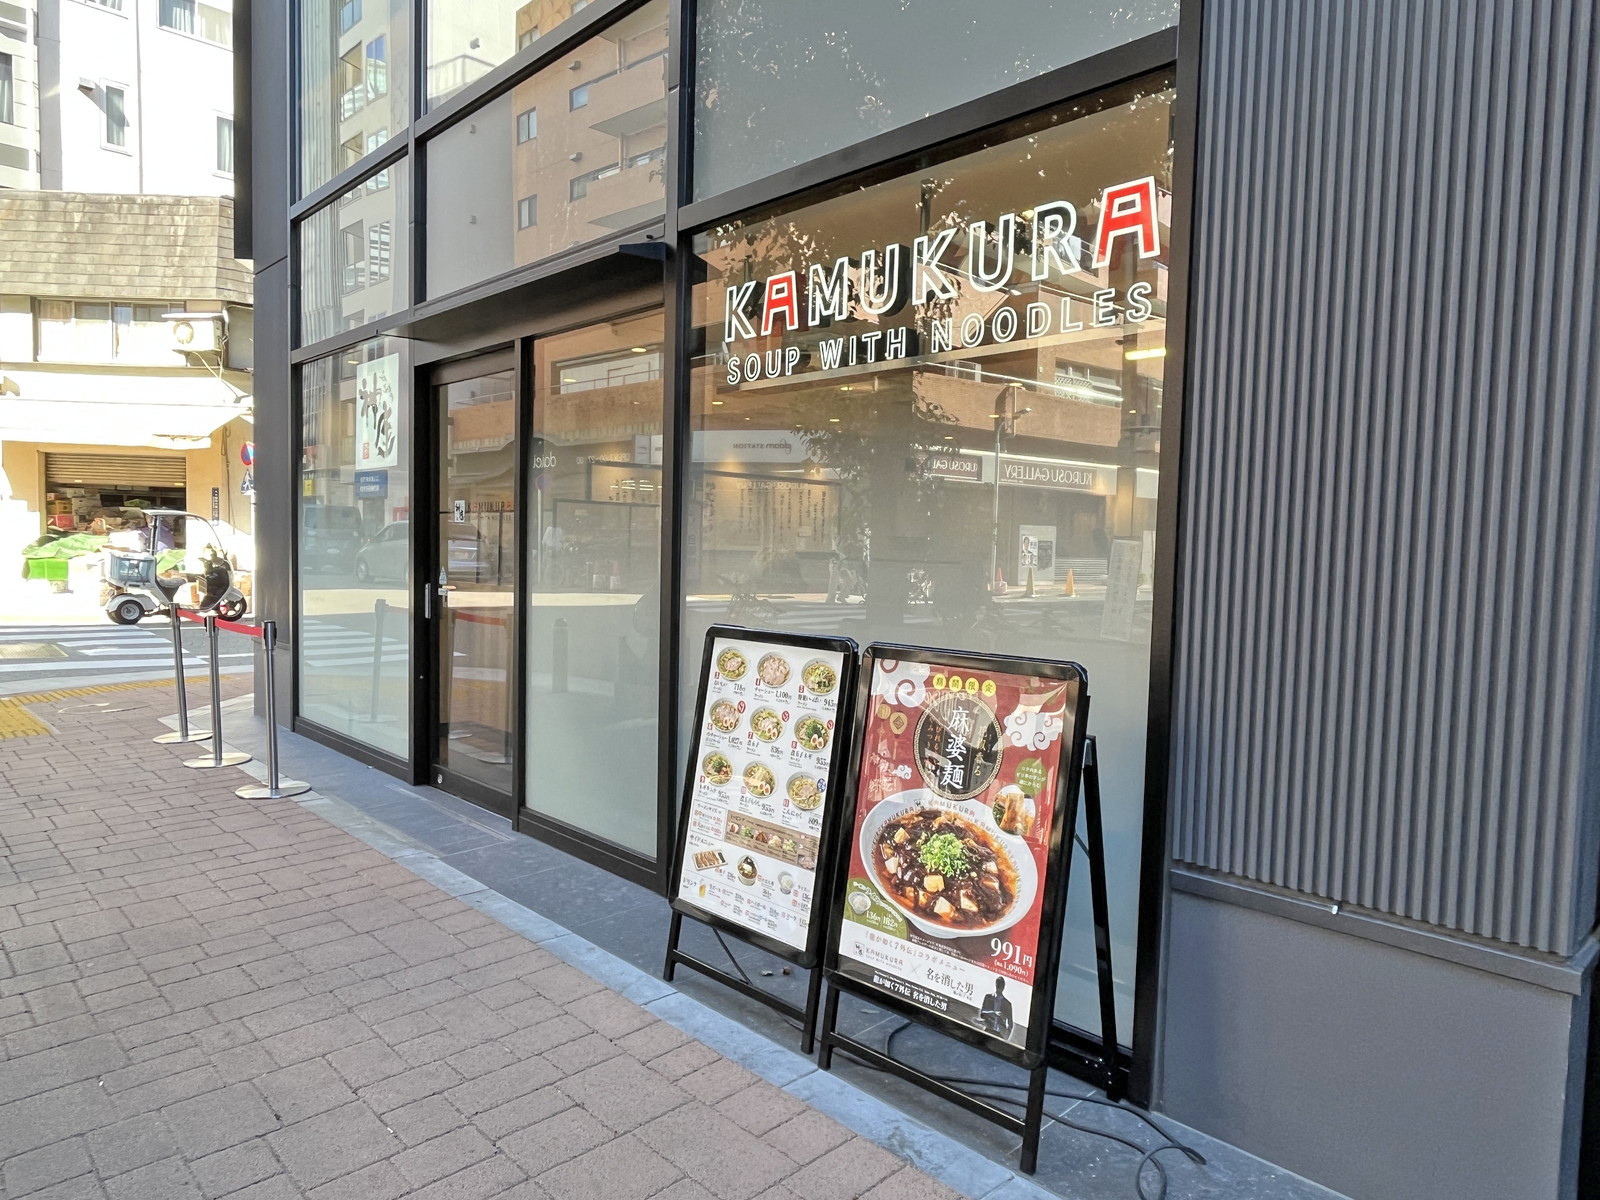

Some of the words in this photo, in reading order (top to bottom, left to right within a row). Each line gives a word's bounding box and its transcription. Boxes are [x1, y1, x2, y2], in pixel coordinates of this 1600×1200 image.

[724, 175, 1161, 344] KAMUKURA
[727, 347, 800, 386] SOUP
[819, 328, 907, 370] WITH
[931, 282, 1153, 353] NOODLES
[935, 676, 994, 694] 期間限定
[940, 706, 970, 789] 麻婆麺
[990, 937, 1032, 968] 991円
[926, 967, 974, 996] 名を消した男
[912, 990, 948, 1012] 名を消した男
